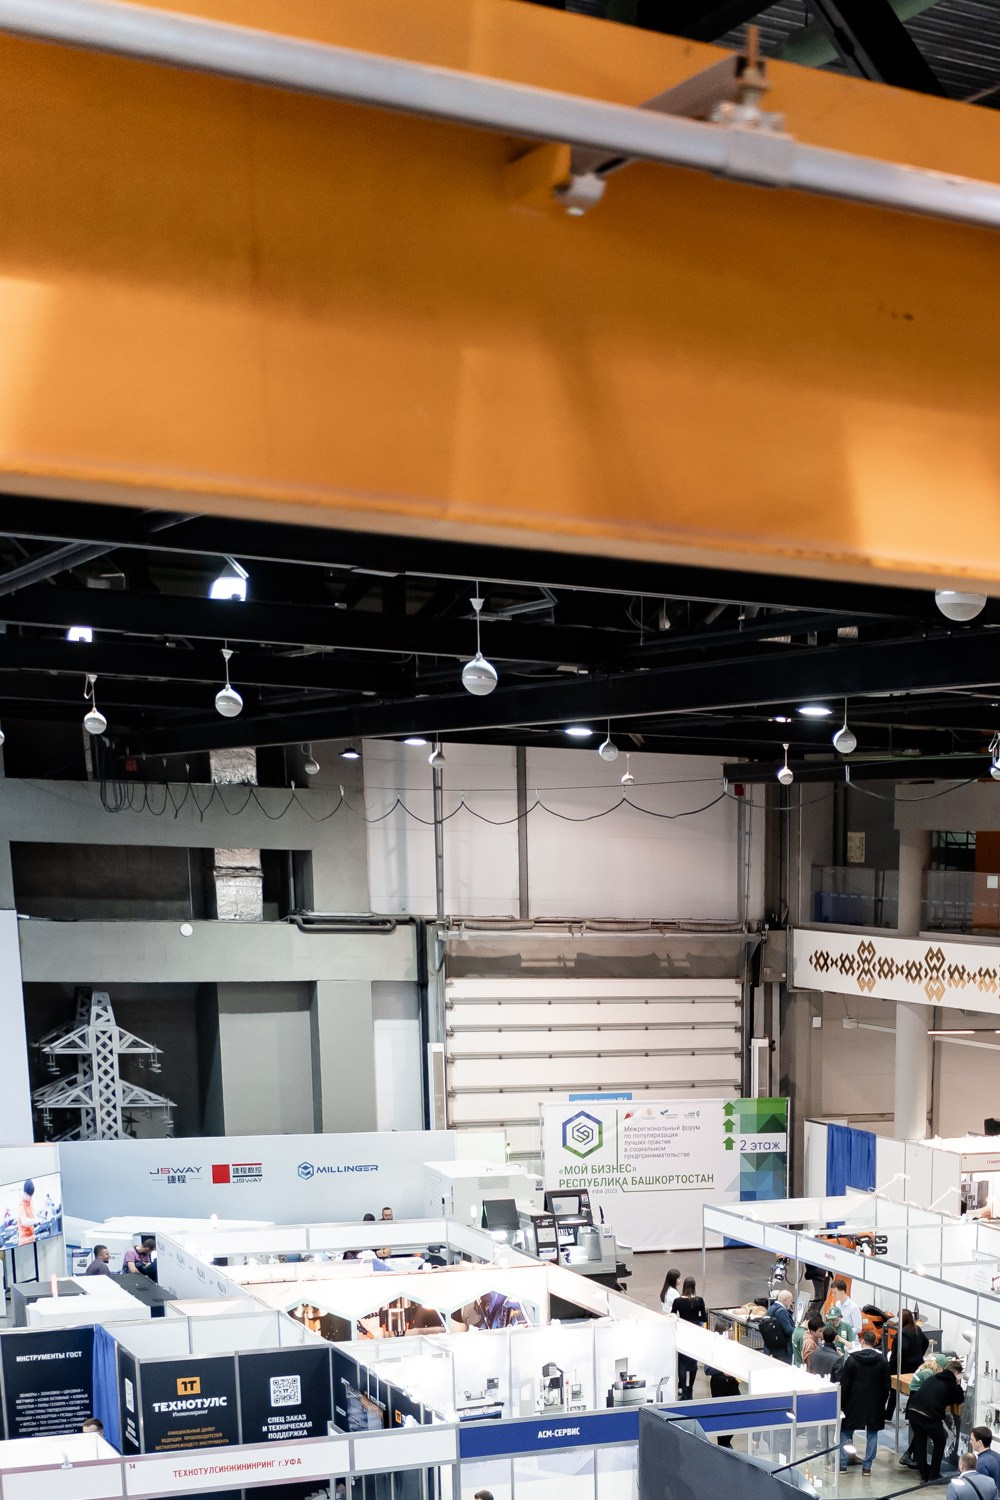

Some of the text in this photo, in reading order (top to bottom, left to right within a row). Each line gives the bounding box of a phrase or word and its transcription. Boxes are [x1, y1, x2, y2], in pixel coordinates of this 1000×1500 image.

[682, 1124, 701, 1133] форум
[740, 1140, 780, 1150] 2 этаж
[149, 1166, 202, 1175] JSWAY
[316, 1164, 379, 1174] MILLINGER
[559, 1174, 714, 1188] РЕСПУБЛИКА БАШКОРТОСТАН
[16, 1351, 83, 1362] ИНСТРУМЕНТЫ ГОСТ
[153, 1396, 228, 1413] ТЕХНОТУЛС
[267, 1414, 307, 1424] СПЕЦ ЗАКАЗ
[268, 1421, 313, 1432] ТЕХНИЧЕСКАЯ
[268, 1429, 308, 1439] ПОДДЕРЖКА
[537, 1427, 580, 1439] АСМ-СЕРВИС
